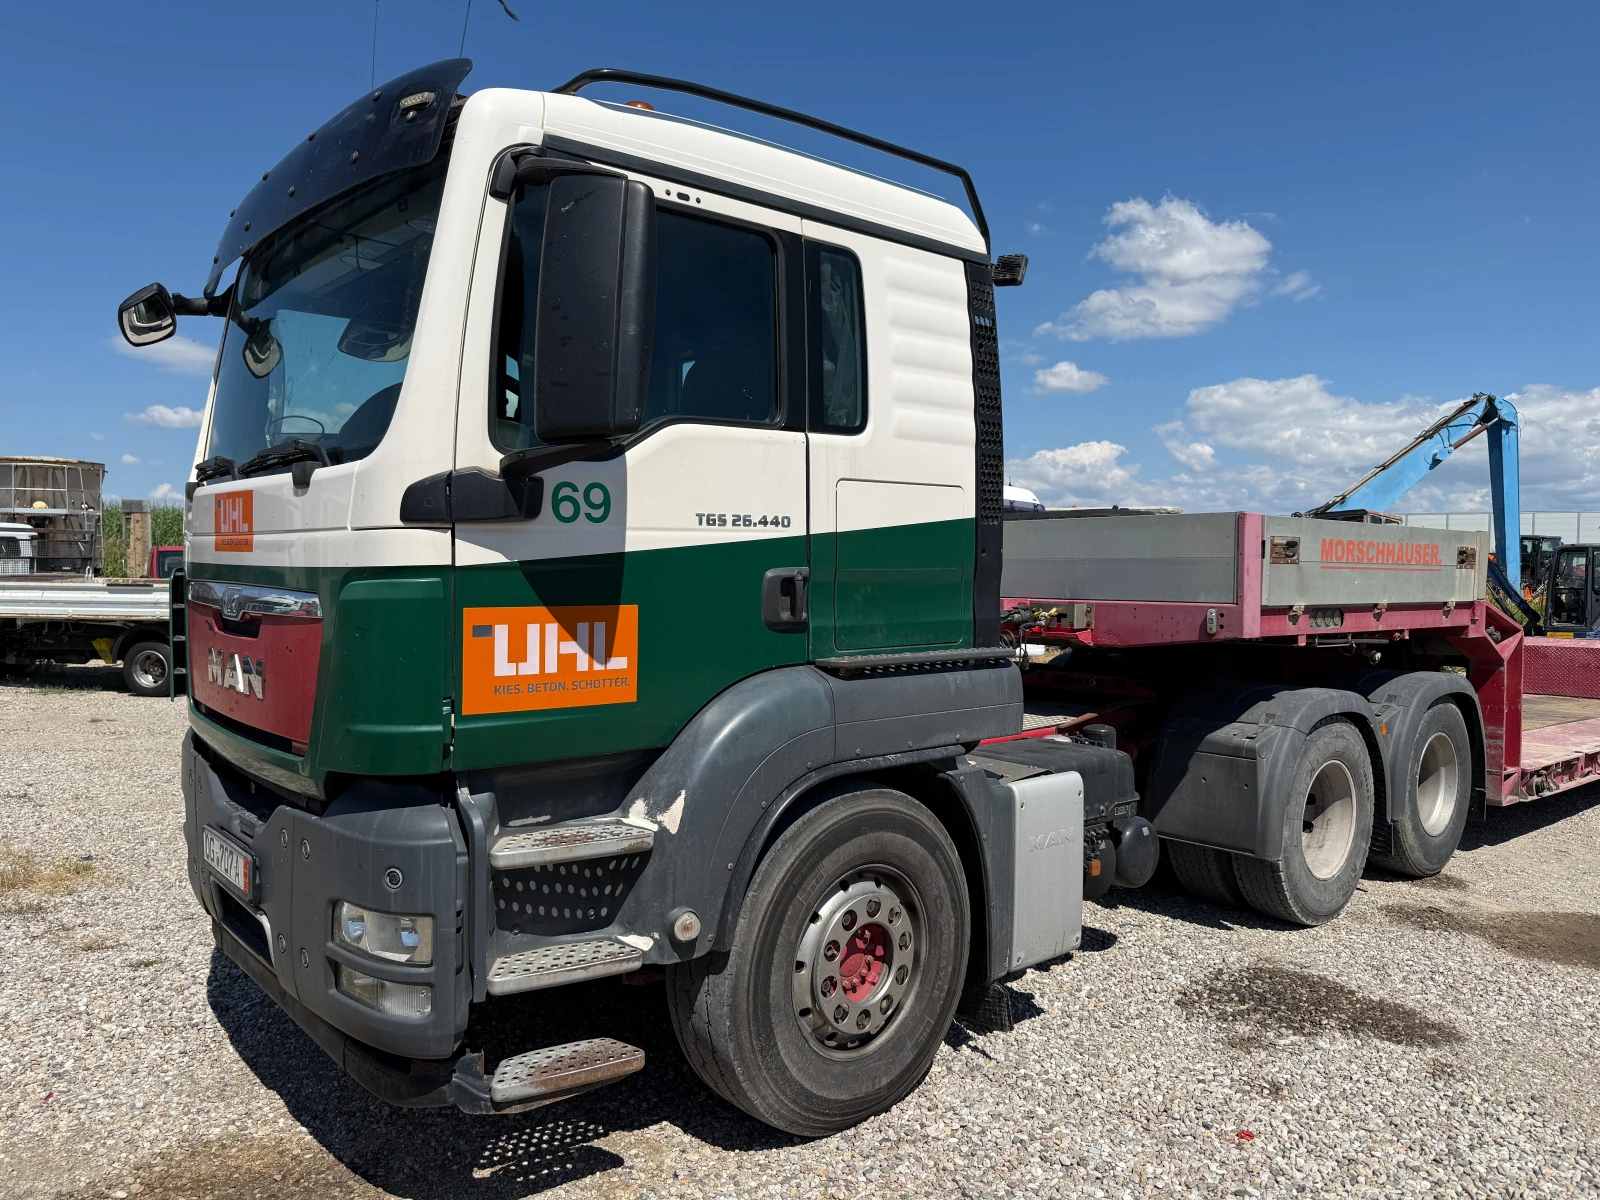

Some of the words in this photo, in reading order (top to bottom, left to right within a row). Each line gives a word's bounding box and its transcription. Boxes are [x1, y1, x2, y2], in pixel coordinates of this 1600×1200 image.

[220, 497, 249, 533] UHL
[551, 481, 612, 524] 69
[695, 512, 728, 527] TGS
[731, 513, 791, 529] 26.440
[1320, 537, 1443, 565] MORSCHHÄUSER.
[493, 621, 628, 677] UHL
[207, 645, 265, 701] MAN
[493, 684, 524, 696] KIES.
[527, 681, 569, 694] BETON.
[571, 677, 631, 692] SCHOTTER.
[1029, 826, 1075, 853] MAN
